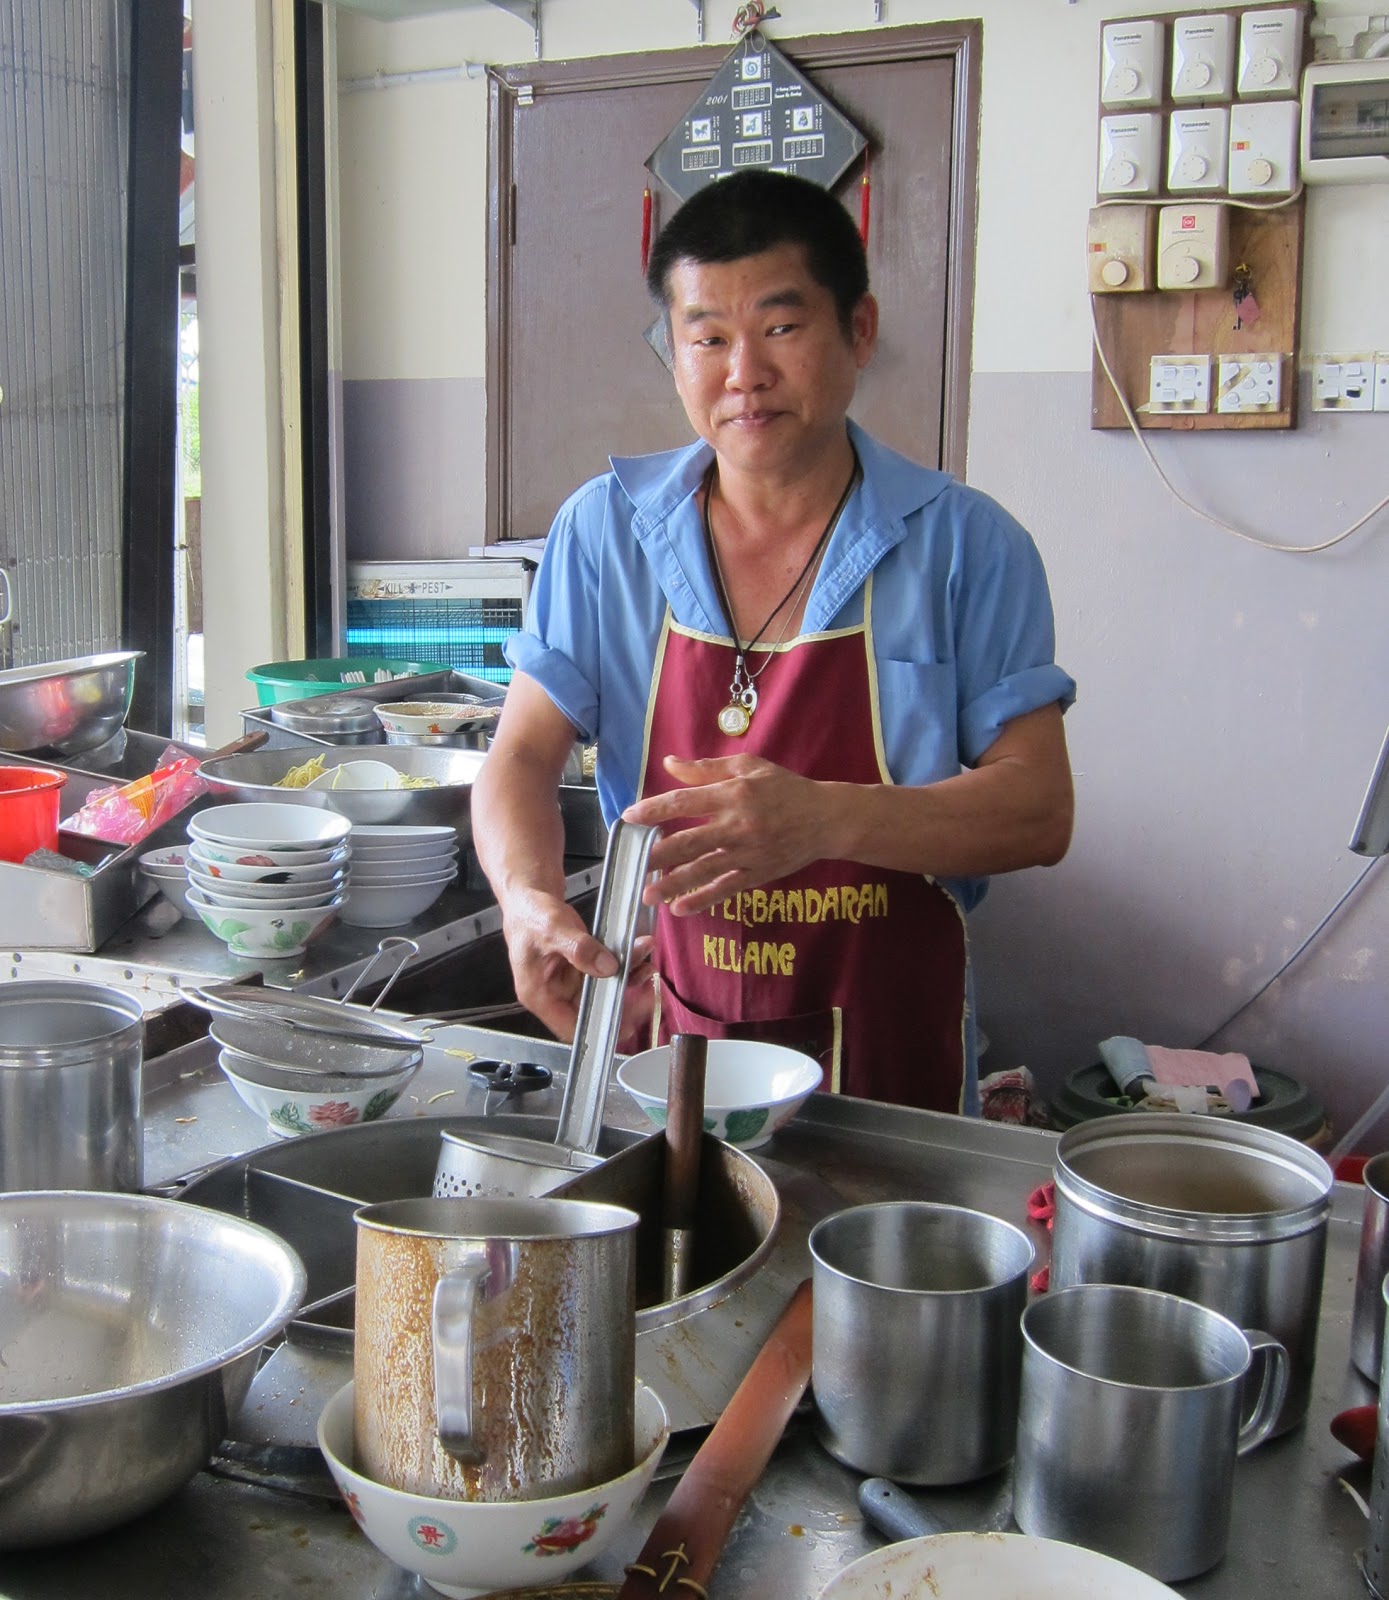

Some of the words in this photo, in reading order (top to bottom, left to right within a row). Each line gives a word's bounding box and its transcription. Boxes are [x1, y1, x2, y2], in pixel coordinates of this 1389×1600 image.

[1252, 22, 1283, 30] Panasonic
[1184, 27, 1215, 35] Panasonic
[1113, 33, 1142, 42] Panasonic
[705, 94, 728, 106] 2001
[1110, 126, 1139, 134] Panasonic
[384, 582, 404, 595] KILL
[422, 581, 445, 594] PEST
